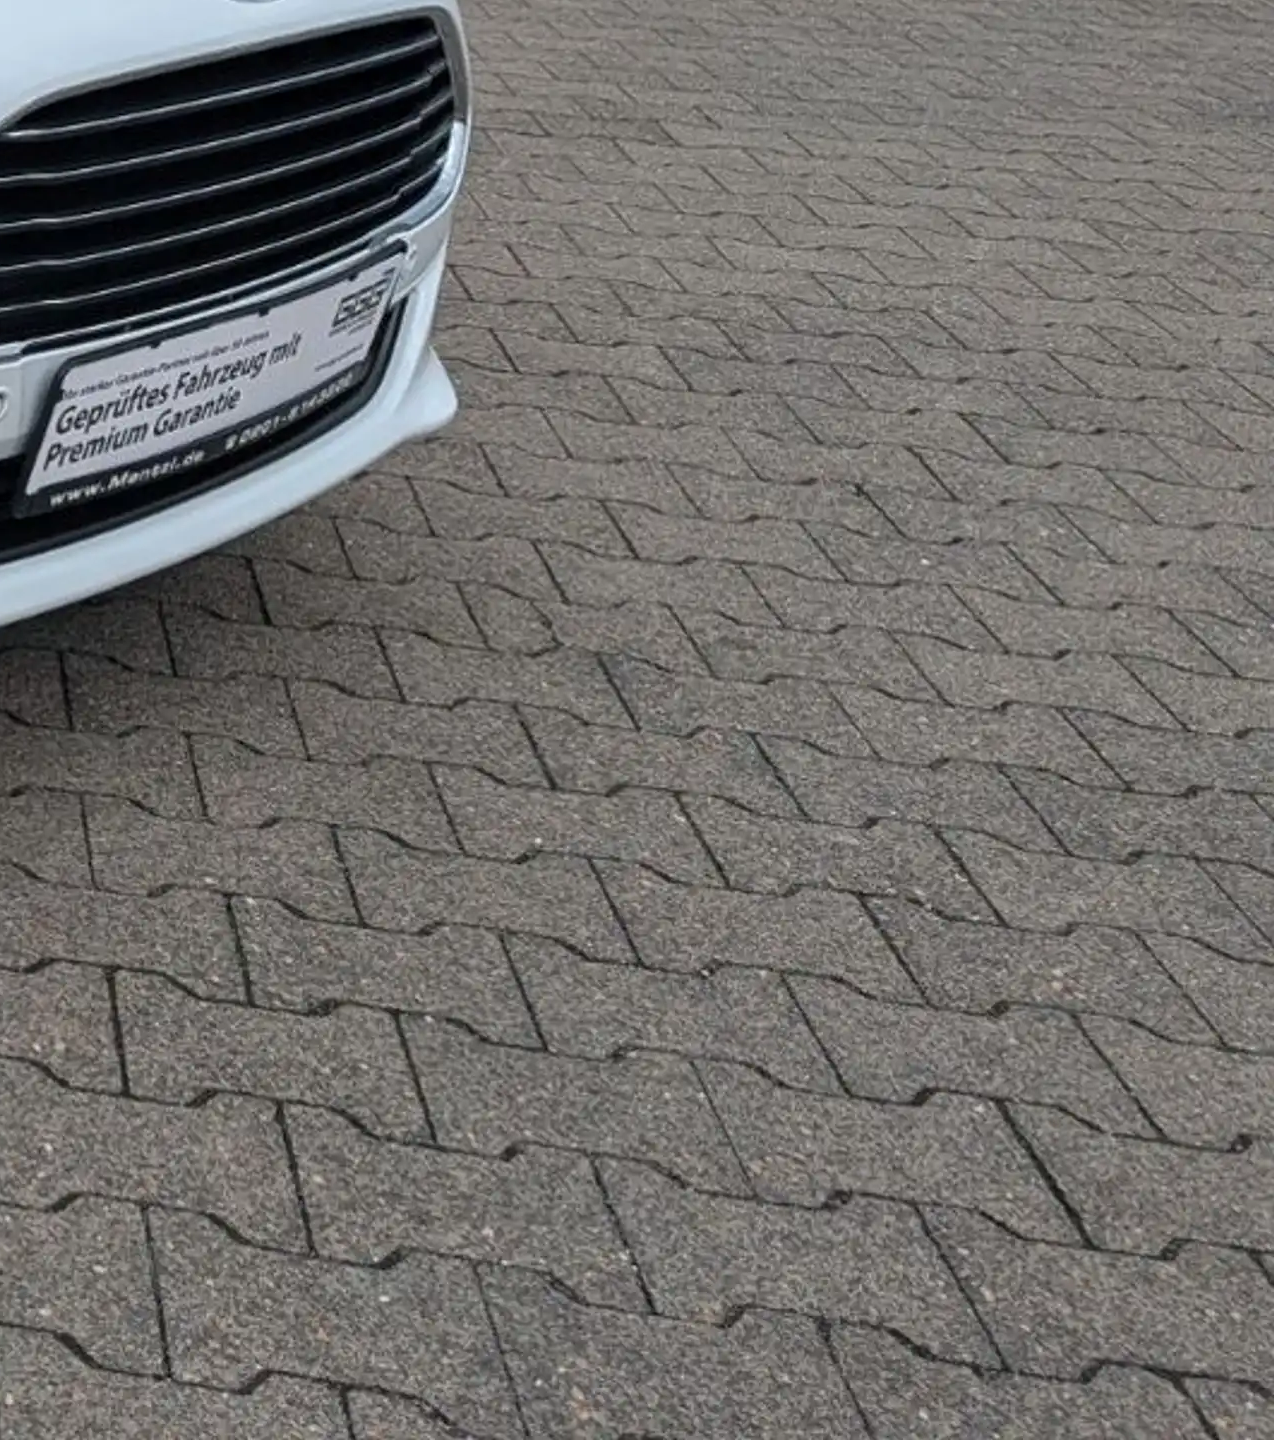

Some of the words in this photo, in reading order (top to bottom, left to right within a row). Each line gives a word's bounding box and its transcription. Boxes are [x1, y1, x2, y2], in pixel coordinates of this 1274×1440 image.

[43, 422, 149, 471] Premium
[152, 385, 242, 437] Garantie
[55, 383, 171, 436] Geprüftes
[173, 350, 268, 401] Fahrzeug
[268, 332, 303, 366] mit
